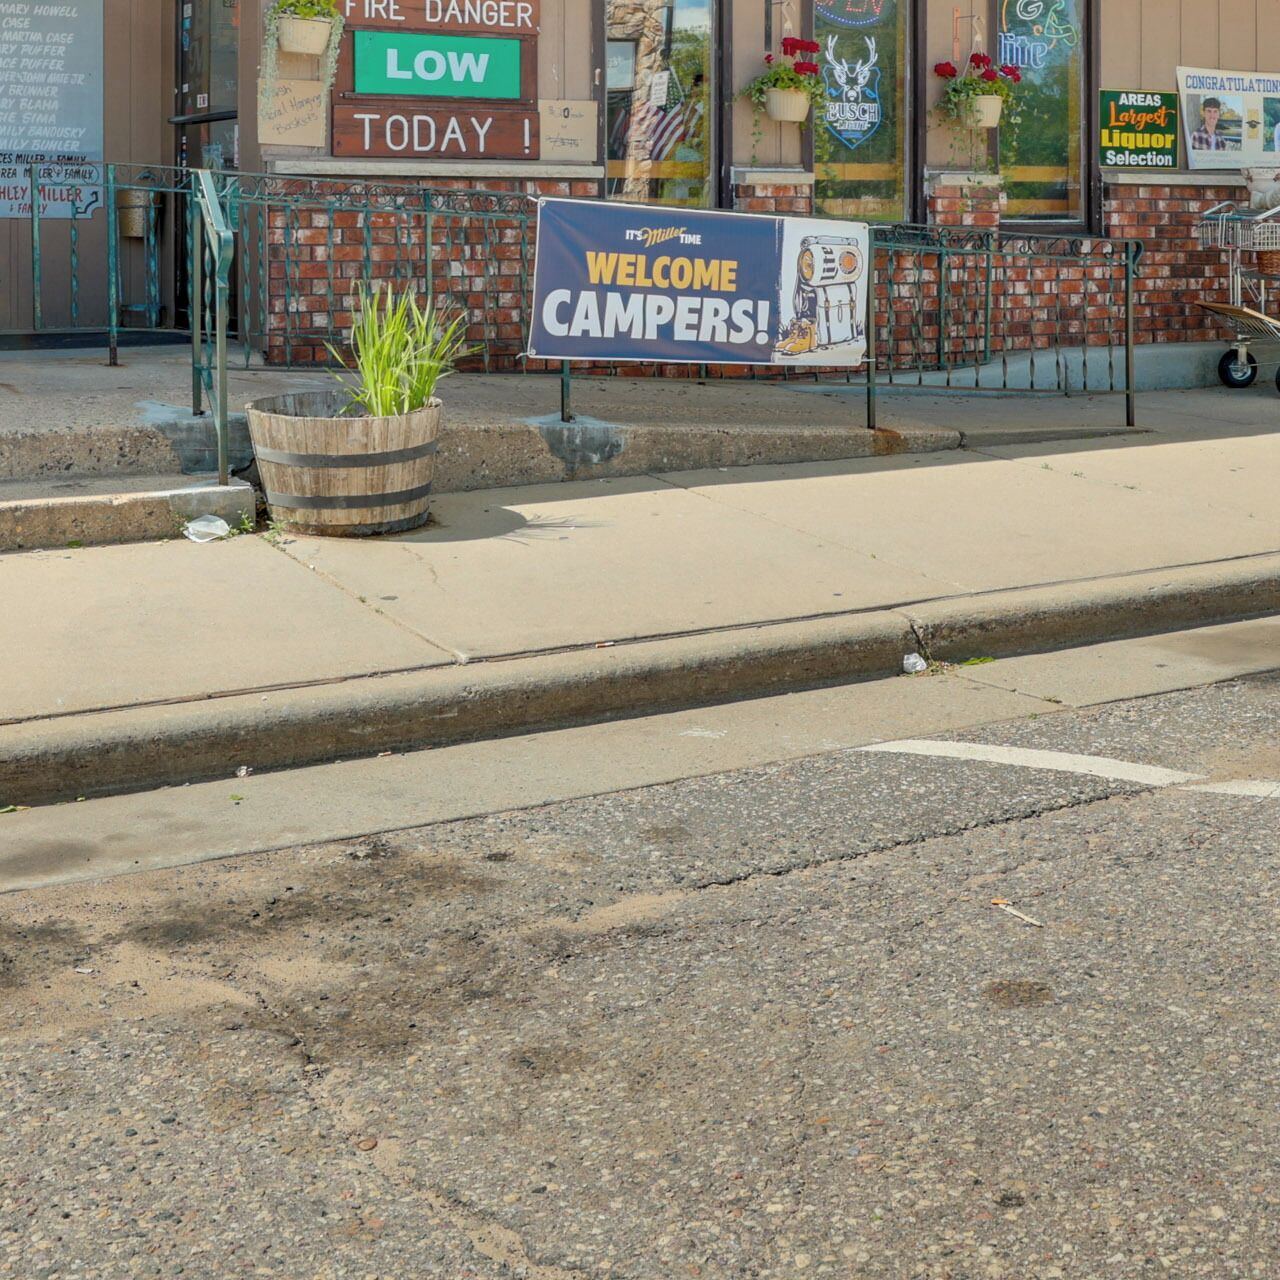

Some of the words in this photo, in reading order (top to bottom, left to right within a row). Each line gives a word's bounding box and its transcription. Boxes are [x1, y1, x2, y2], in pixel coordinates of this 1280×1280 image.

[34, 5, 78, 17] HOWELL
[2, 17, 31, 29] CASE
[46, 32, 75, 44] CASE
[21, 45, 66, 57] PUFFER
[20, 58, 65, 71] PUFFER
[386, 48, 490, 83] LOW
[1119, 93, 1161, 107] AREAS
[826, 102, 878, 122] BUSCH
[1109, 101, 1176, 130] Largest
[353, 114, 493, 153] TODAY
[1101, 129, 1175, 150] Liquor
[1106, 150, 1172, 166] Selection
[23, 168, 54, 179] MLER
[625, 229, 644, 241] IT'S
[642, 226, 688, 248] Miller
[680, 233, 702, 245] TIME
[586, 251, 738, 292] WELCOME
[542, 288, 770, 345] CAMPERS!
